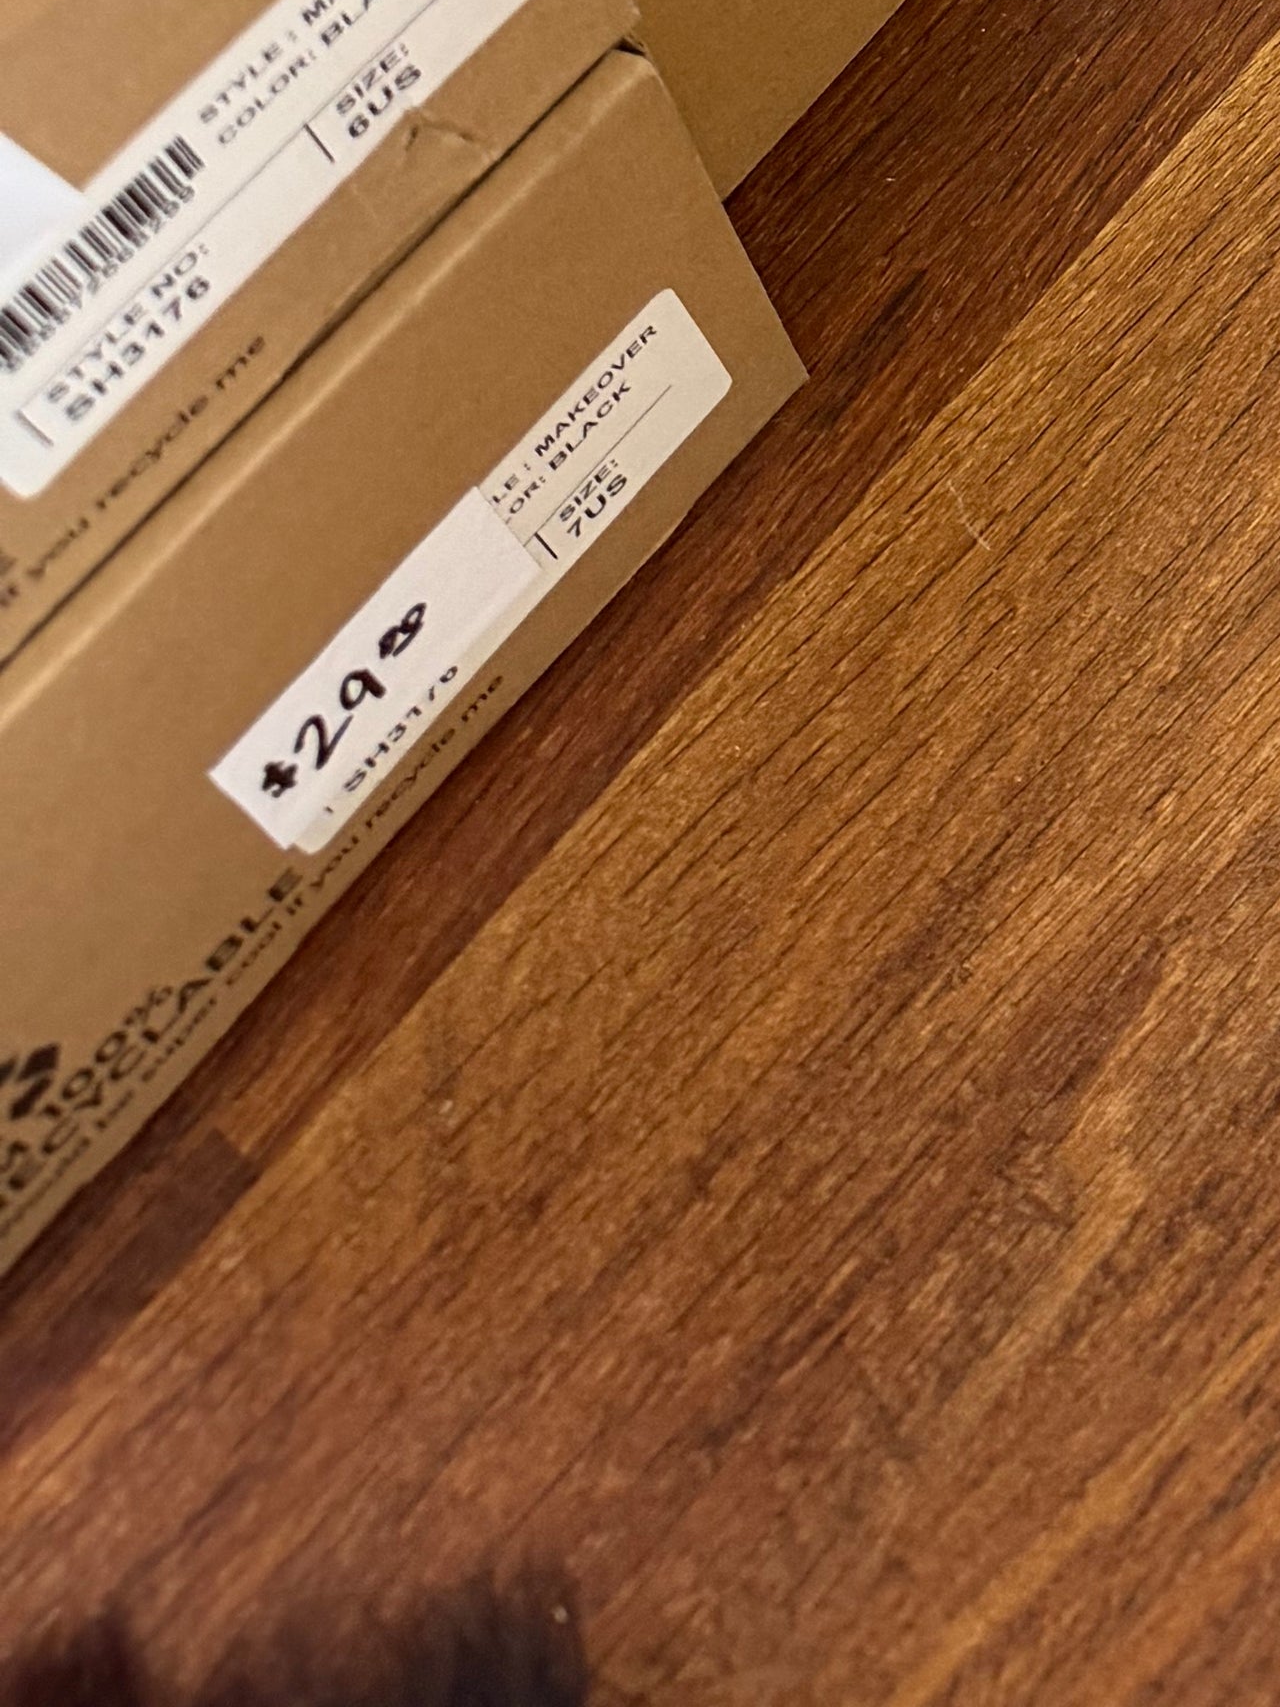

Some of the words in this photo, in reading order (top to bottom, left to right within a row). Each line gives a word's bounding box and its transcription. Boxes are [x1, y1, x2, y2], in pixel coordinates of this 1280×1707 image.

[198, 44, 284, 125] STYLE
[218, 46, 320, 147] COLOR:
[335, 41, 411, 117] SIZE:
[346, 64, 423, 141] 6US
[48, 303, 145, 404] STYLE
[156, 241, 210, 293] NO:
[65, 275, 211, 423] SH3176
[95, 394, 210, 510] recycle
[215, 335, 267, 390] me
[534, 323, 659, 458] MAKEOVER
[548, 379, 633, 472] BLACK
[558, 457, 620, 523] SIZE:
[566, 472, 631, 540] 7US
[225, 920, 282, 987] cool
[308, 833, 359, 890] you
[365, 727, 457, 830] recycle
[461, 673, 505, 722] me
[0, 866, 303, 1209] ECYCLABLE
[37, 985, 173, 1121] 100%
